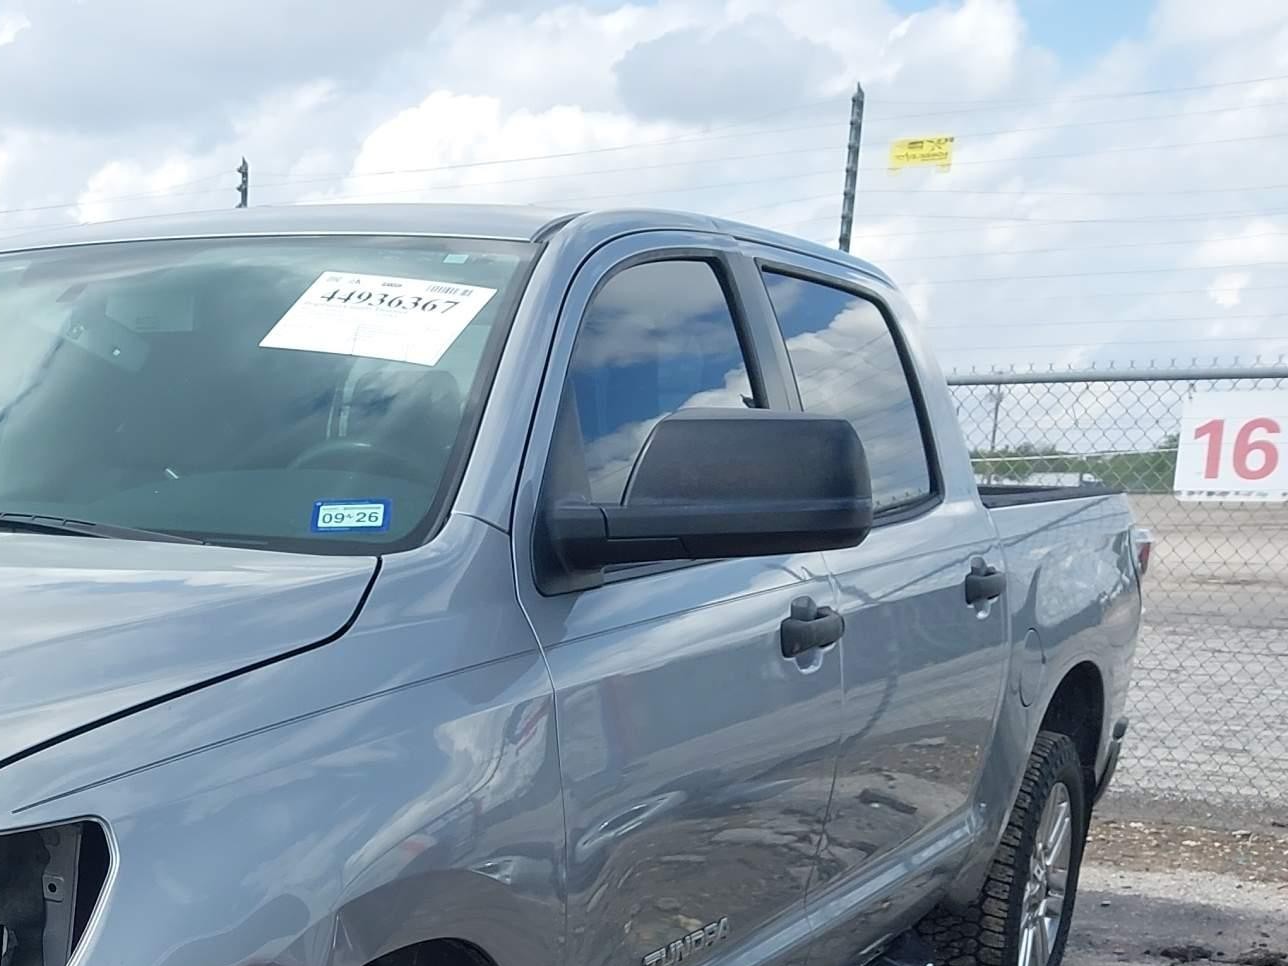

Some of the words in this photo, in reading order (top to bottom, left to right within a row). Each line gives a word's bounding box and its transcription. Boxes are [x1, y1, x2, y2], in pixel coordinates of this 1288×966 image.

[320, 287, 460, 314] 44936367
[1193, 417, 1281, 480] 16
[322, 512, 345, 524] 09
[355, 511, 380, 523] 26
